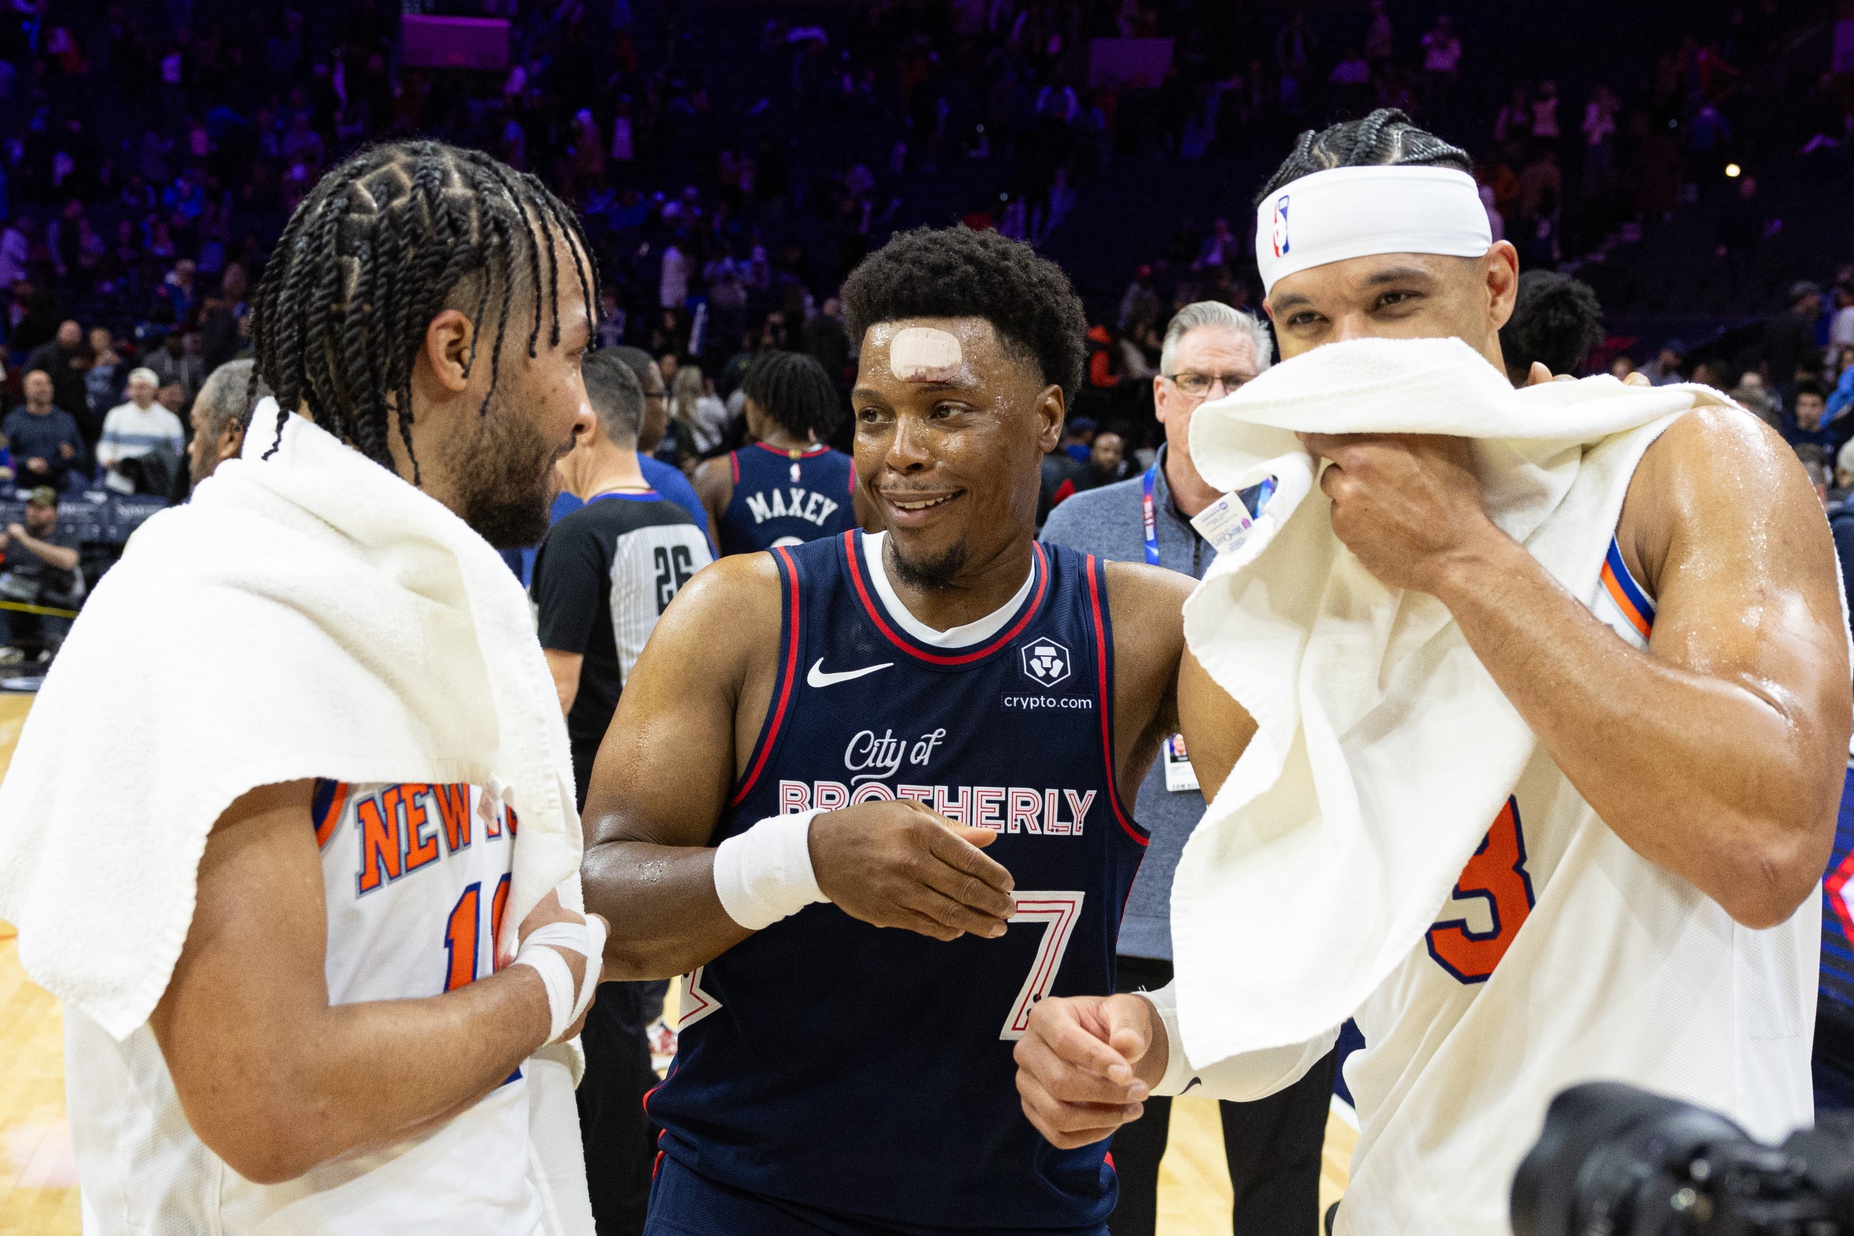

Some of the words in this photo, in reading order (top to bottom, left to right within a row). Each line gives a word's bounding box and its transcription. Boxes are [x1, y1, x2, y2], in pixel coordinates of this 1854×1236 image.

[745, 487, 839, 527] MAXEY
[1004, 695, 1093, 710] crypto.com
[844, 728, 907, 786] City
[910, 728, 946, 766] of
[354, 782, 472, 900] NEW
[999, 890, 1086, 1041] 7
